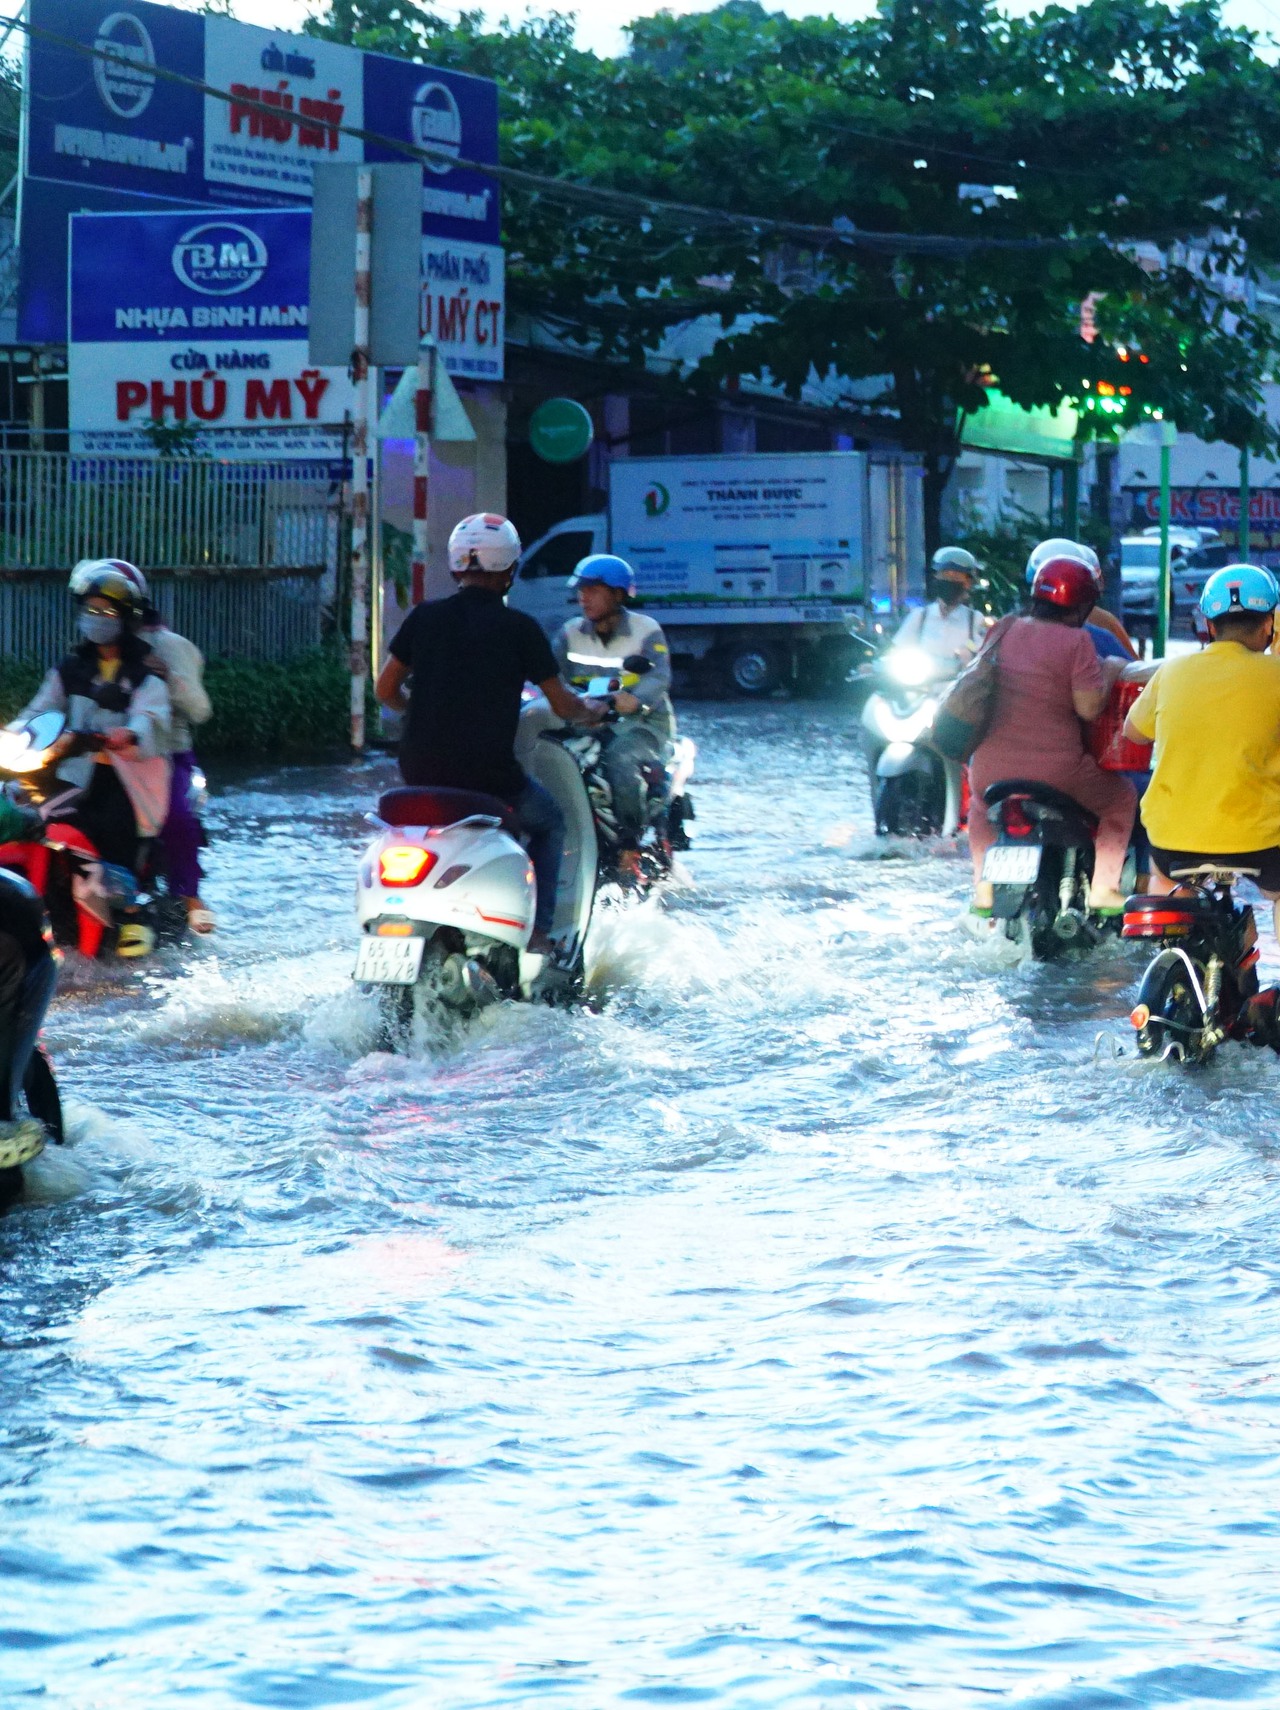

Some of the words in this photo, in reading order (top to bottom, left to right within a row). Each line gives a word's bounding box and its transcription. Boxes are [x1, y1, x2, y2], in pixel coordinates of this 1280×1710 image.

[191, 242, 249, 268] BM
[476, 299, 501, 347] CT
[170, 348, 210, 371] CỬA
[215, 349, 270, 370] HÀNG
[116, 371, 227, 422] PHÚ
[245, 370, 330, 421] MỸ
